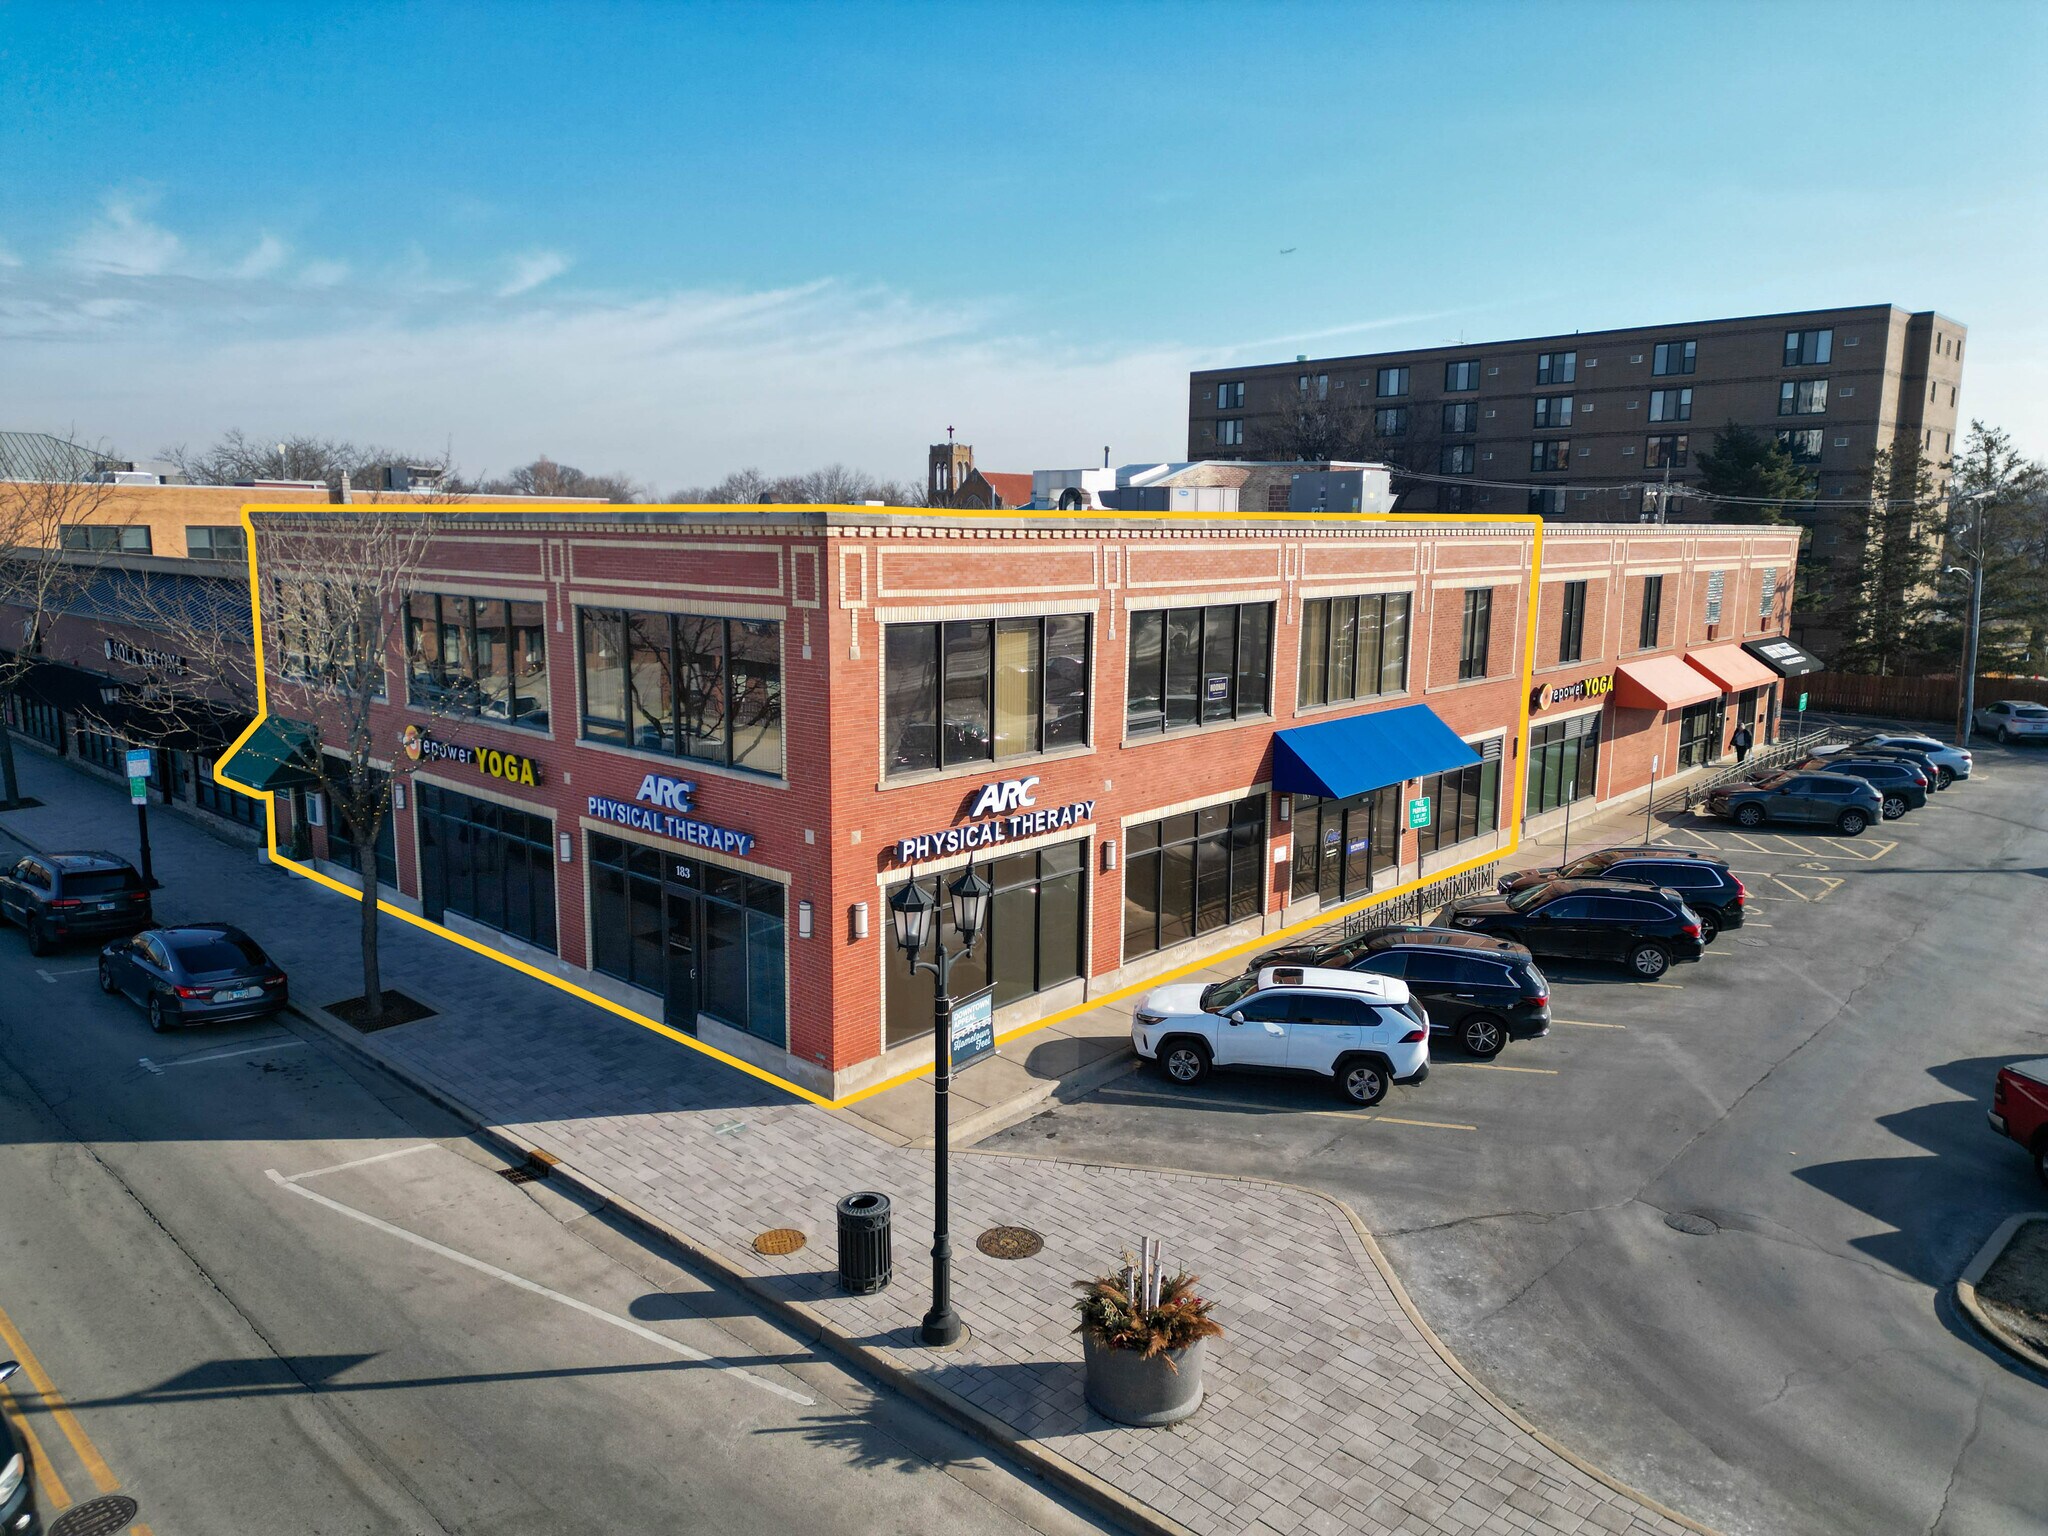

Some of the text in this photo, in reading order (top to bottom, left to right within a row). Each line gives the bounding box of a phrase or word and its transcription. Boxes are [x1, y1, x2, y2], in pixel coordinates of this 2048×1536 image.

[113, 642, 138, 665] SOLA
[1585, 675, 1613, 697] YOGA
[475, 746, 535, 787] YOGA
[636, 775, 692, 813] ARC
[971, 776, 1040, 818] ARC
[588, 796, 746, 856] PHYSICAL THERAPY
[902, 801, 1096, 863] PHYSICAL THERAPY
[675, 865, 691, 879] 183
[953, 998, 990, 1020] DOWNTOWN
[953, 1013, 977, 1029] APPEAL
[953, 1029, 991, 1051] Hometown
[975, 1036, 991, 1051] Feel
